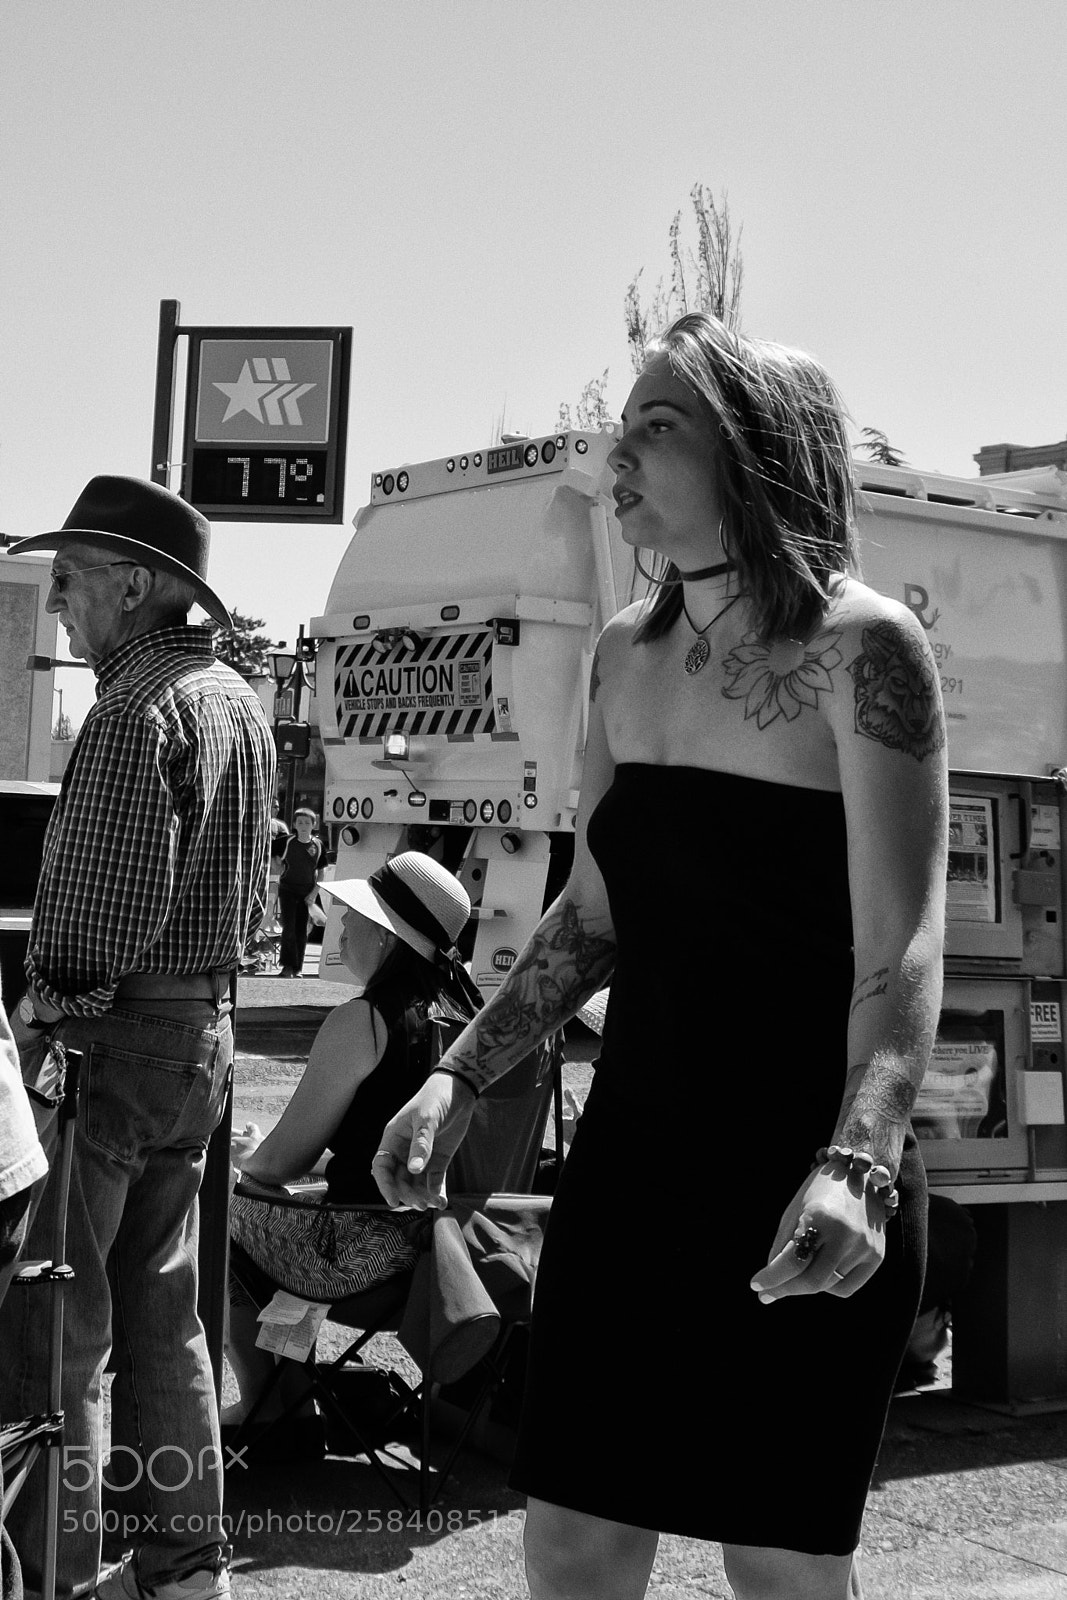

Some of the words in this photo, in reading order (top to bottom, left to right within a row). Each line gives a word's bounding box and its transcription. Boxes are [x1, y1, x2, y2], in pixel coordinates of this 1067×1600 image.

[488, 449, 520, 470] HEIL
[360, 664, 454, 697] CAUTION
[344, 699, 366, 711] VEHICLE
[367, 698, 385, 710] STOPS
[386, 697, 397, 709] AND
[398, 696, 417, 708] BACKS
[418, 694, 455, 708] FREQUENTLY
[968, 1045, 989, 1055] LIVE
